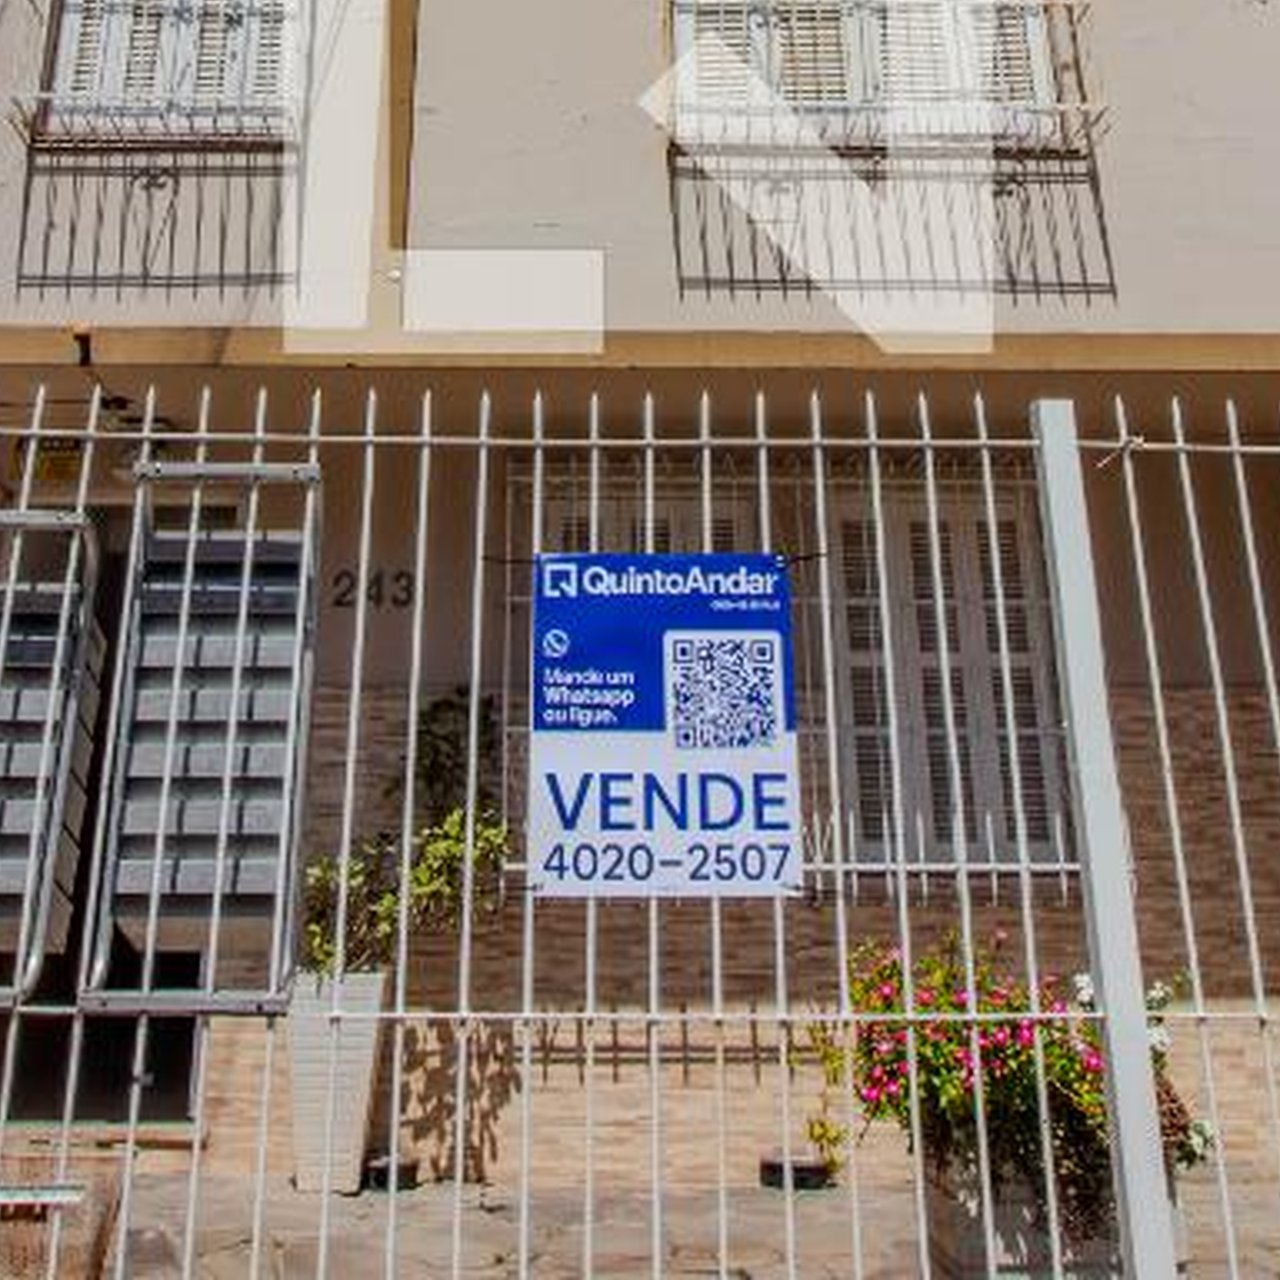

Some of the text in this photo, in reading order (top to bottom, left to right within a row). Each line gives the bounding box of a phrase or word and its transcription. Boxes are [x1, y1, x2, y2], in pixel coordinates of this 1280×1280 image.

[332, 570, 413, 607] 243
[583, 566, 779, 596] QuintoAndar
[606, 672, 634, 684] um
[542, 709, 567, 721] ou
[545, 773, 791, 831] VENDE
[543, 844, 791, 881] 4020-2507
